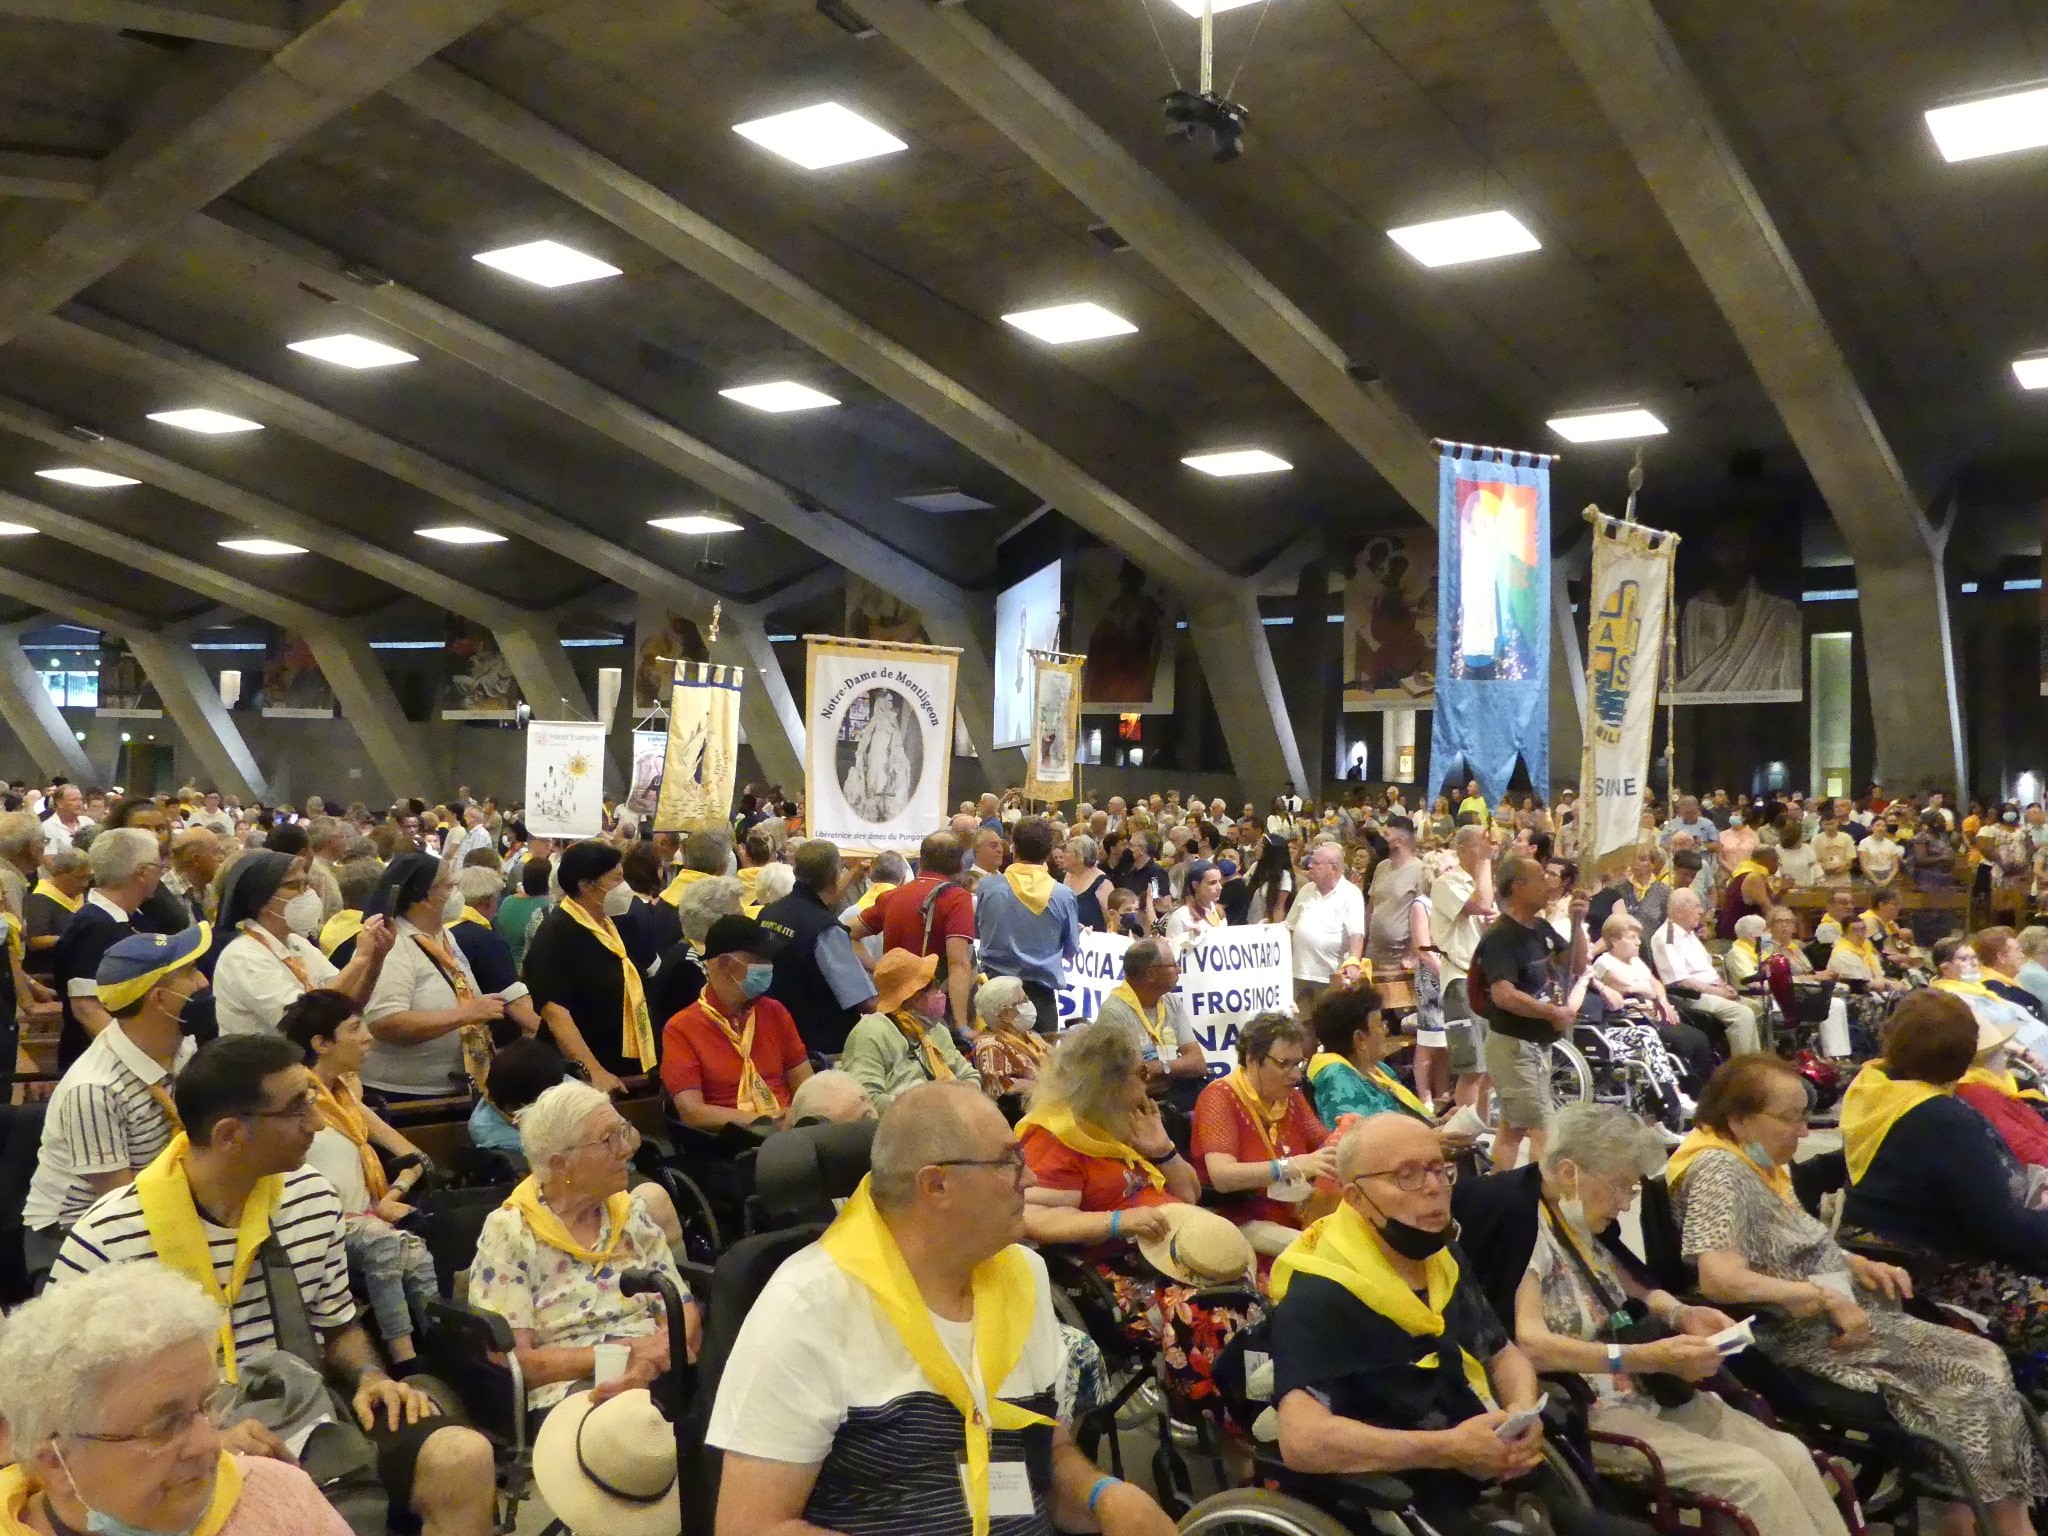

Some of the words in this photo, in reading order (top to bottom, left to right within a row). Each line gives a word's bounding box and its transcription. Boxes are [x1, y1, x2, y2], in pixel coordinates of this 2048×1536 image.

[821, 670, 877, 719] Notre-Dame
[881, 667, 893, 679] de
[896, 672, 939, 726] Montligeon
[854, 832, 866, 840] des
[888, 832, 897, 840] du
